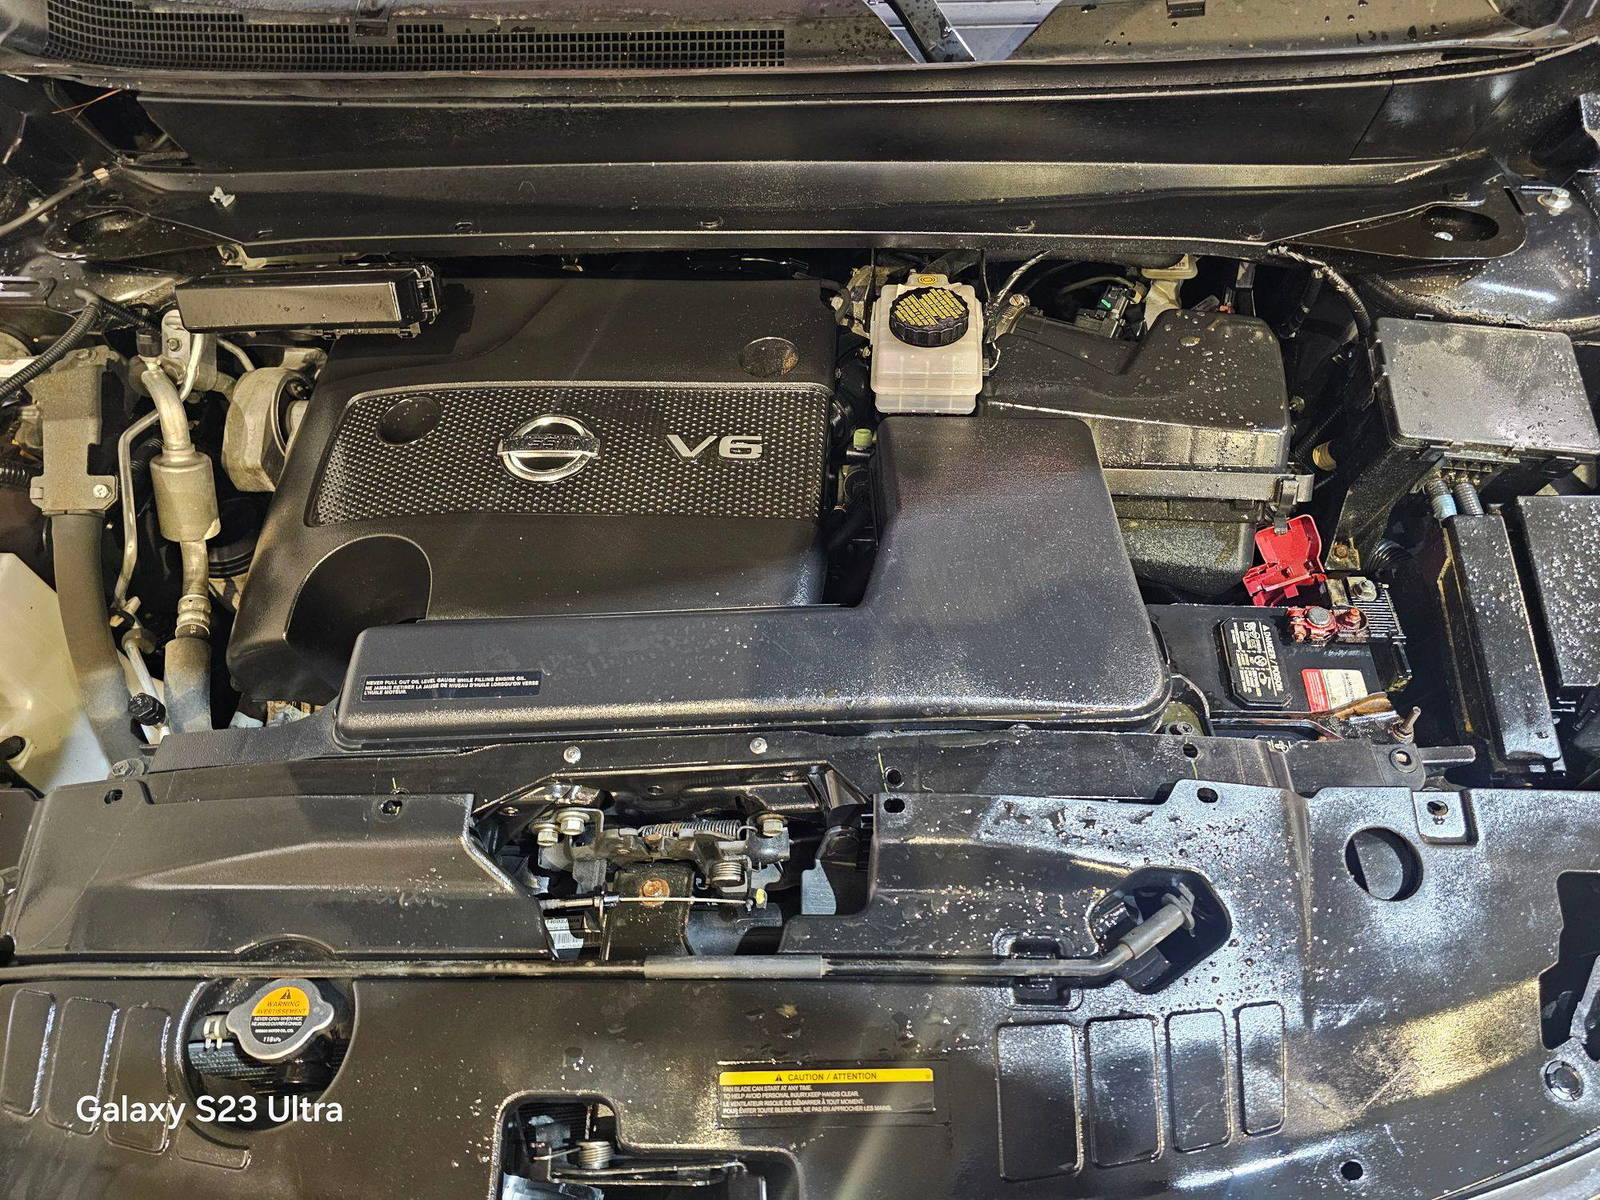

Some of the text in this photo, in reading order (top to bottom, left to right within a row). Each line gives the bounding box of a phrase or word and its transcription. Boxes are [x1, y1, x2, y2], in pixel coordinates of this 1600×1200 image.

[665, 434, 763, 459] V6
[1264, 632, 1276, 660] DANGER
[1272, 666, 1284, 692] POISON
